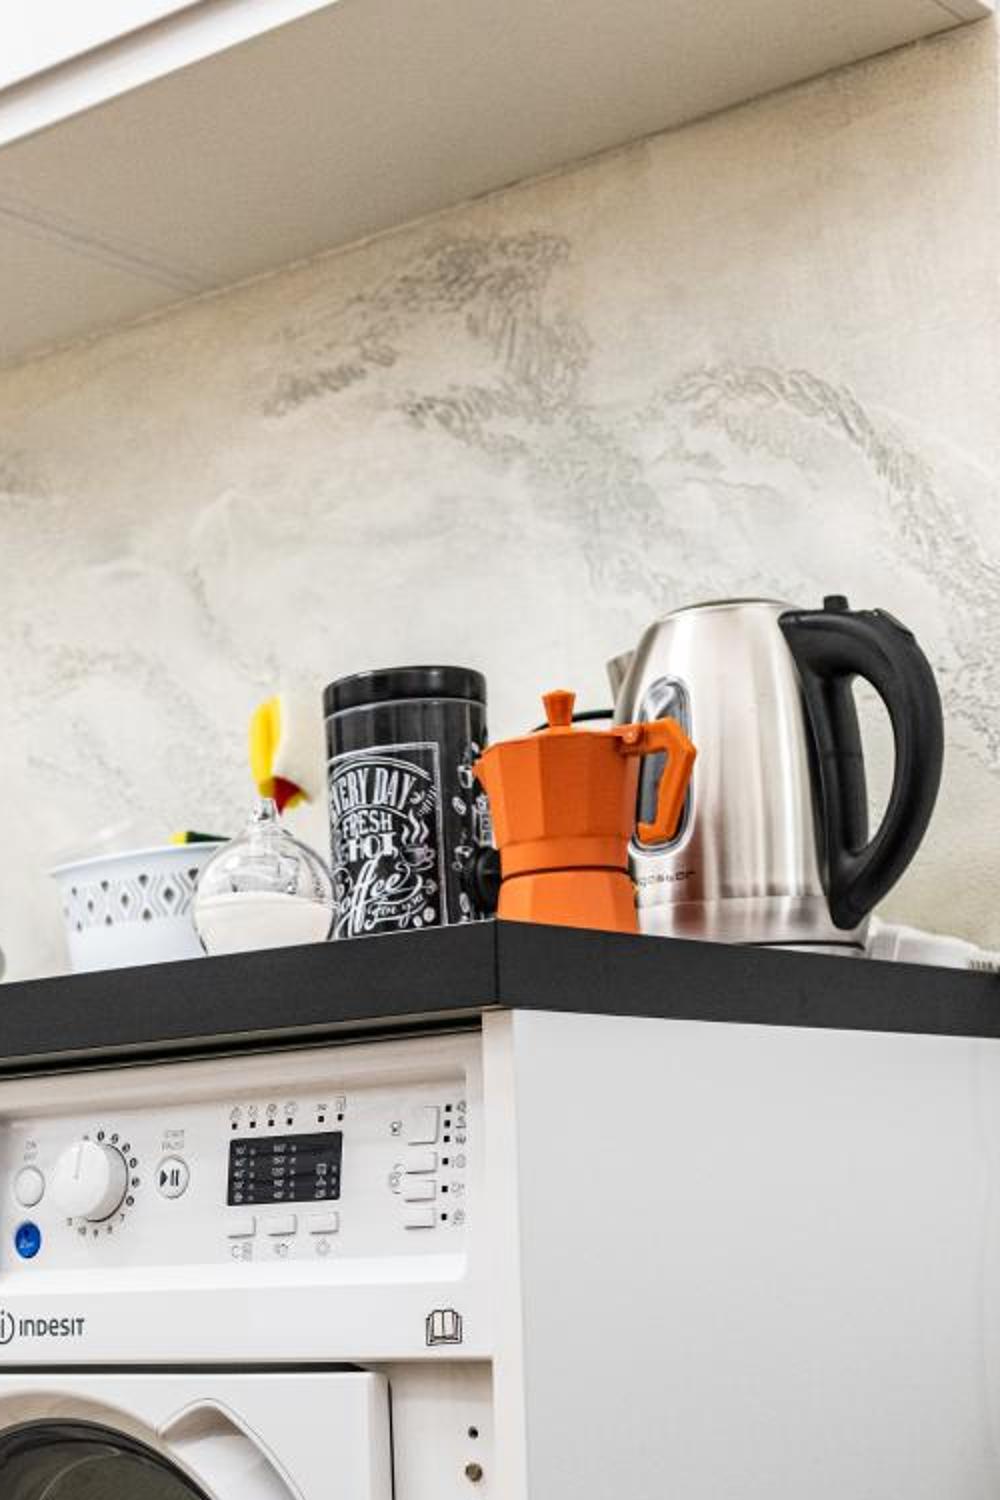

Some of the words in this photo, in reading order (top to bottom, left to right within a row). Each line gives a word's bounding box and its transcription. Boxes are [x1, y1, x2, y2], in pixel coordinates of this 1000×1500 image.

[331, 767, 370, 818] VERY
[373, 767, 417, 811] DAY
[342, 810, 393, 839] FRESH
[344, 832, 399, 863] HOT
